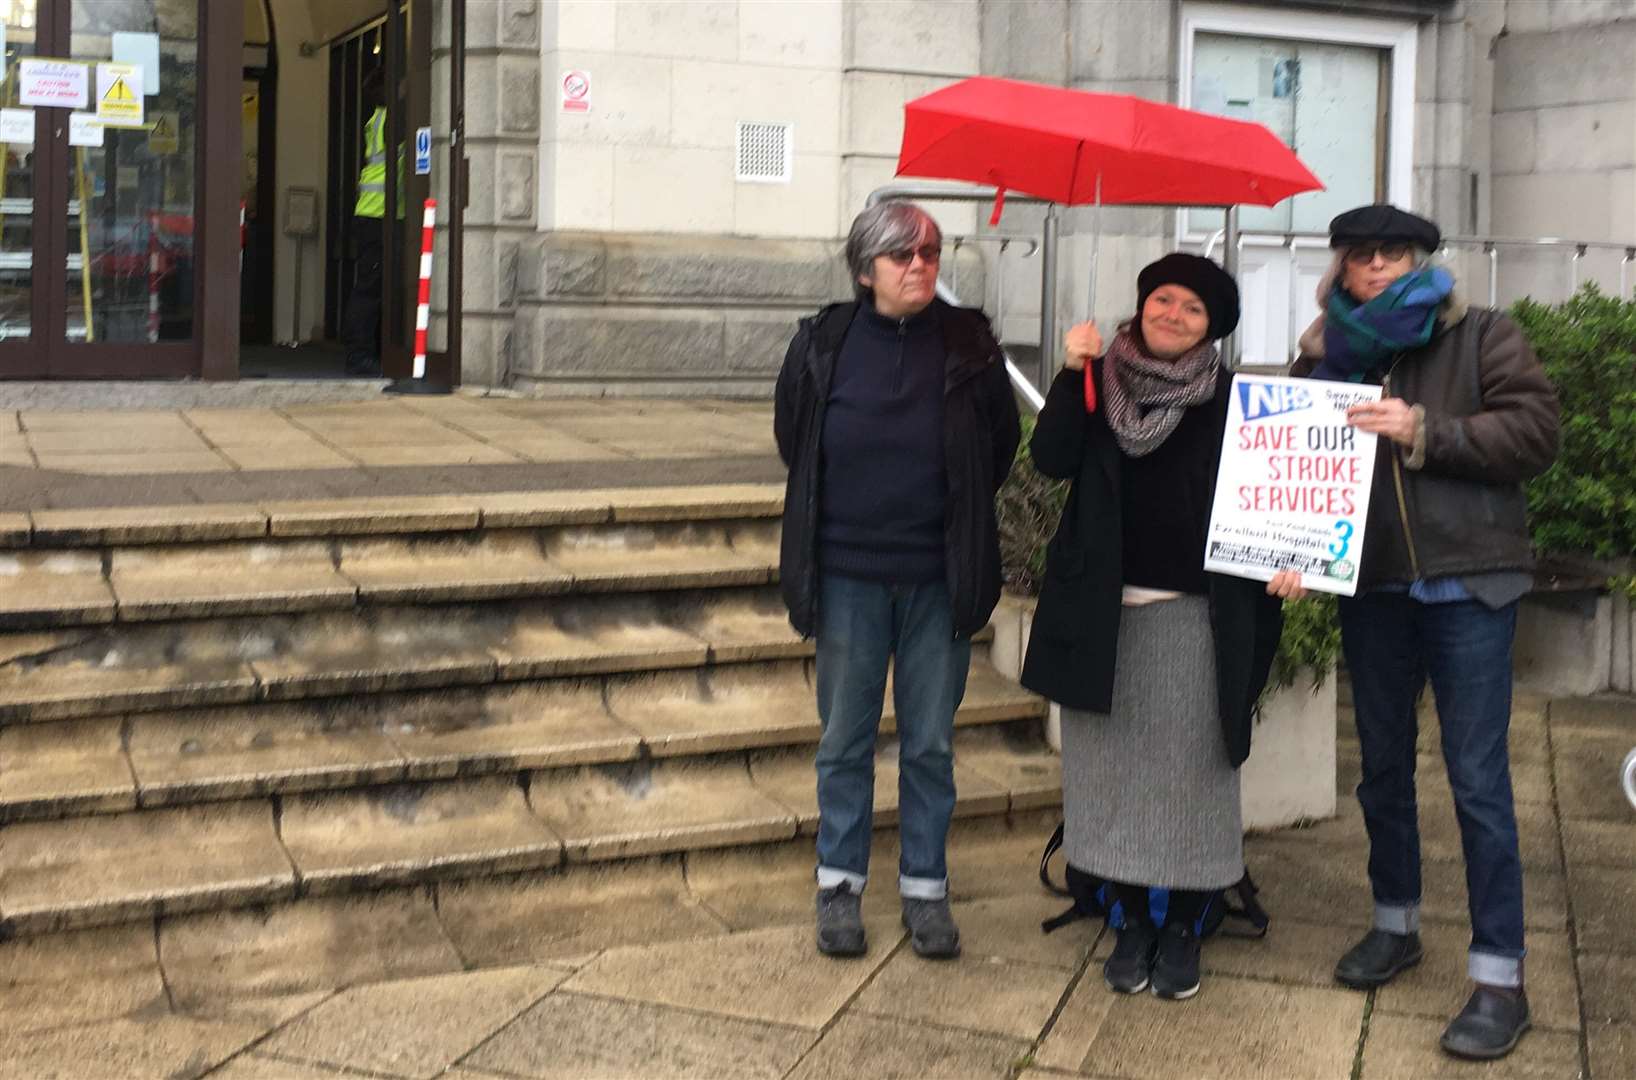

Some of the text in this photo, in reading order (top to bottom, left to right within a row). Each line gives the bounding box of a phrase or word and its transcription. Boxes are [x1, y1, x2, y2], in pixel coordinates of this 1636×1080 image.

[1246, 384, 1314, 418] NHS
[1238, 425, 1355, 451] SAVE OUR
[1268, 455, 1362, 483] STROKE
[1239, 485, 1356, 516] SERVICES
[1272, 531, 1327, 551] Hospitals
[1328, 519, 1355, 558] 3
